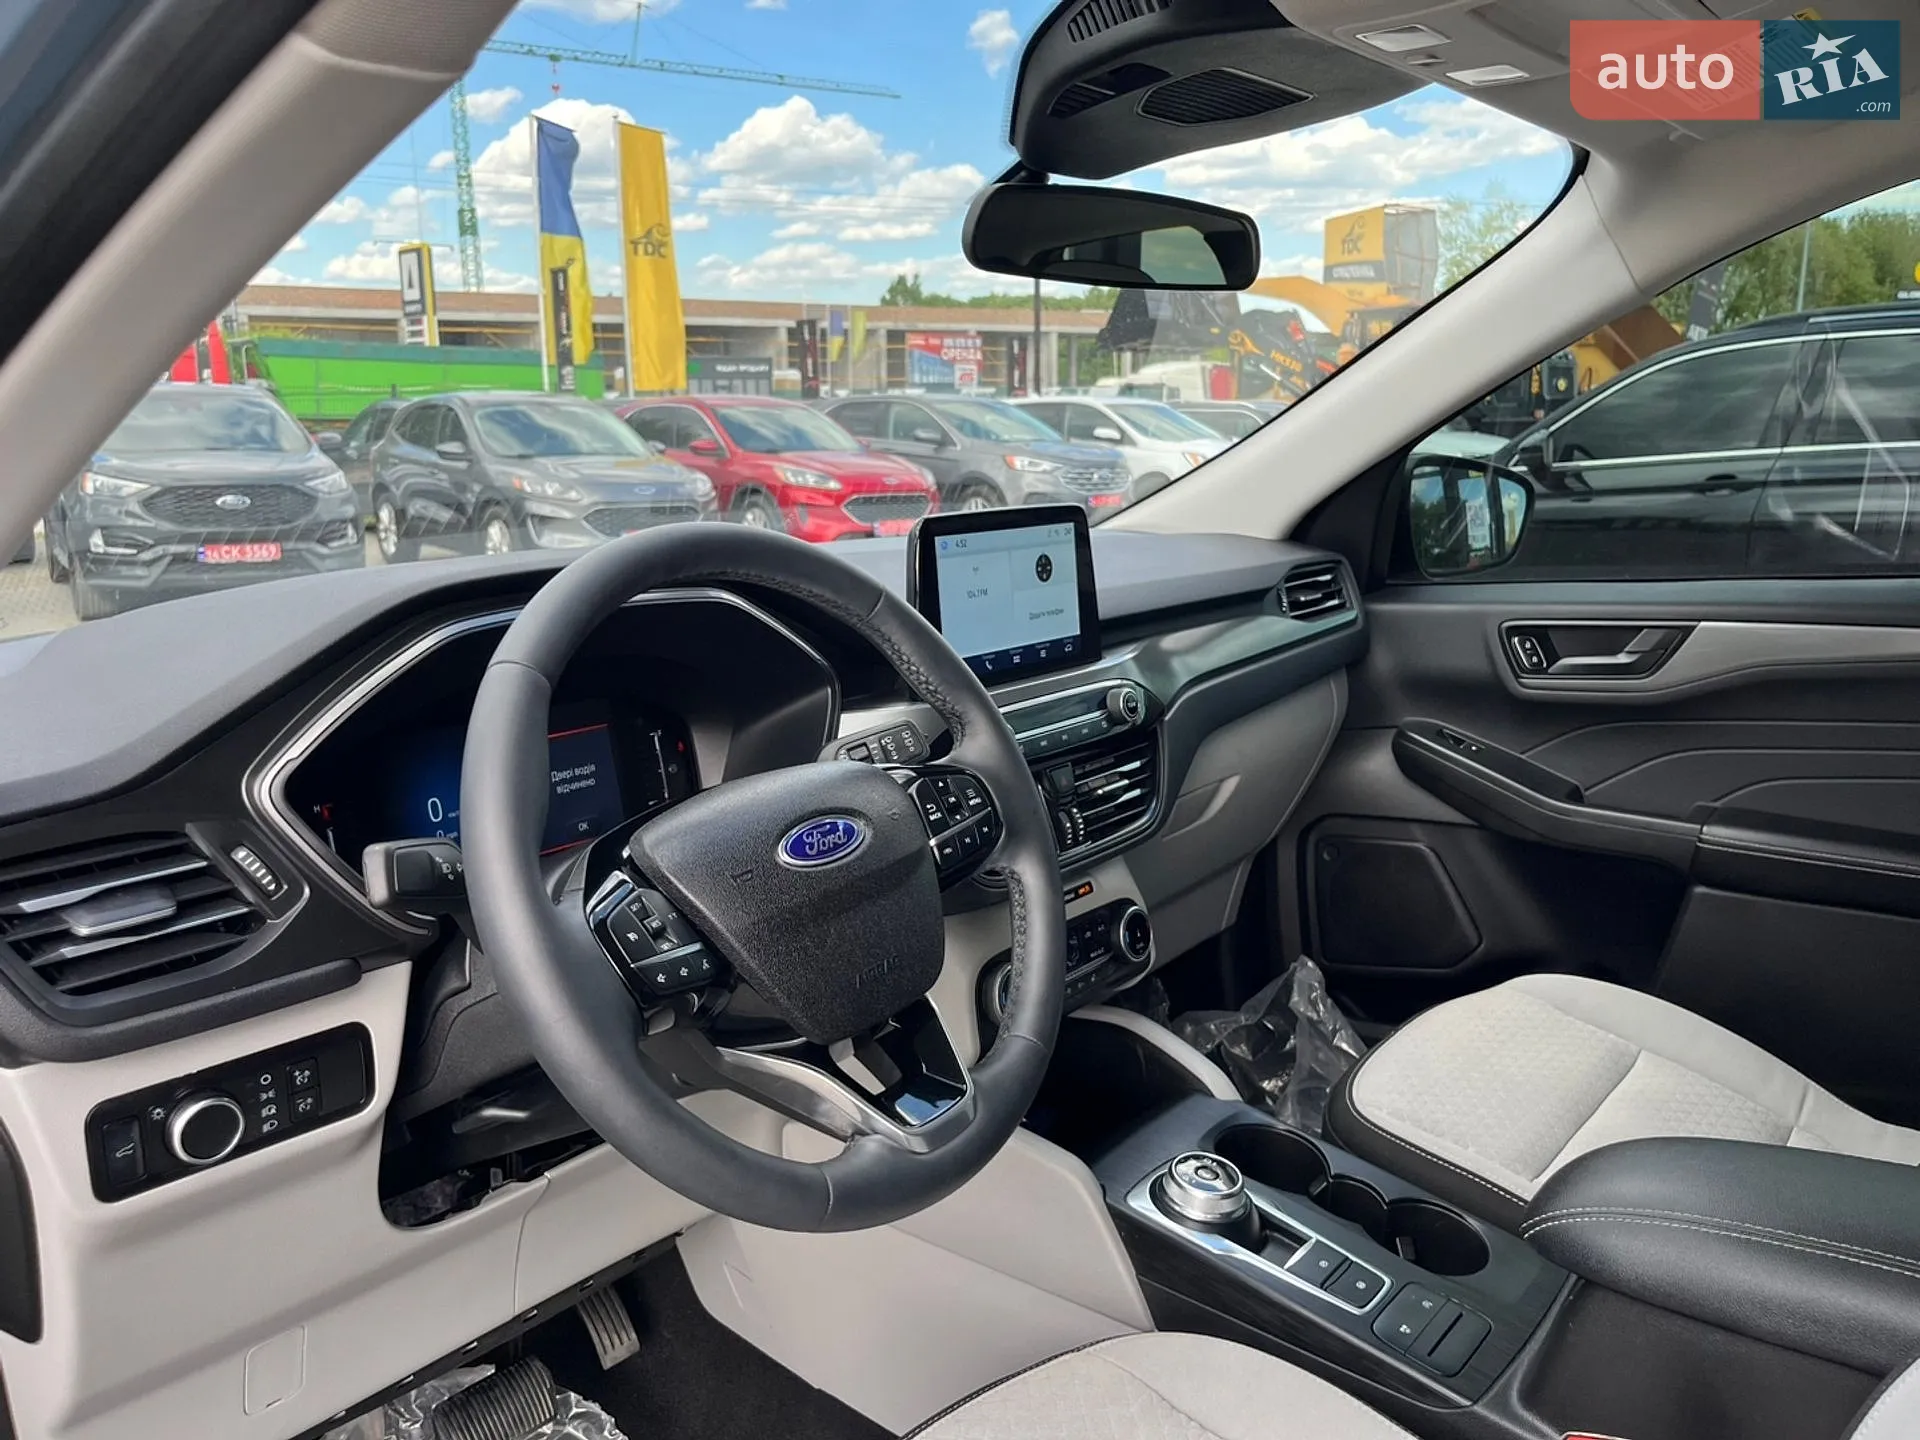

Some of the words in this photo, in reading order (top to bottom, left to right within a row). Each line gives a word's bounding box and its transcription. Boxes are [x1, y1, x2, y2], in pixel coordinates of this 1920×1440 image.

[551, 767, 574, 783] Двері
[427, 797, 443, 823] 0
[578, 821, 590, 832] OK
[803, 822, 847, 856] Ford
